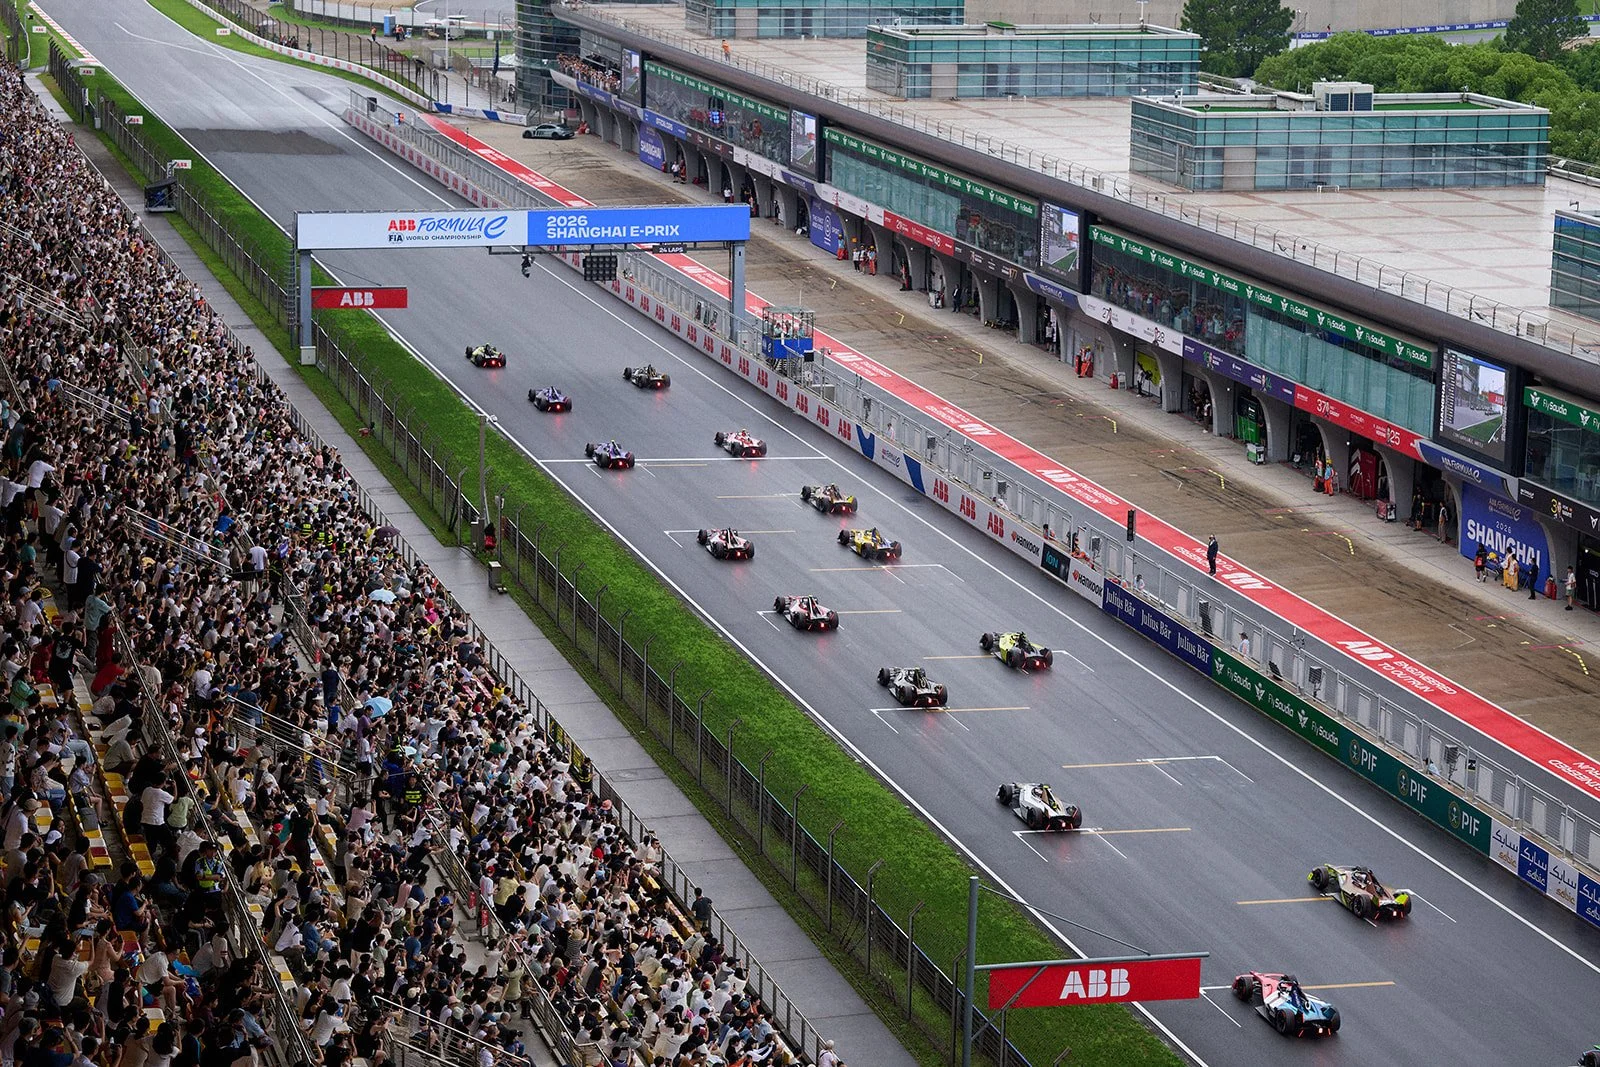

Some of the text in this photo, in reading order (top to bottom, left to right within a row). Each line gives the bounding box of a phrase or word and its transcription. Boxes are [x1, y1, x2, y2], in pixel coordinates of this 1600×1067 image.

[388, 220, 416, 231] ABB
[417, 217, 484, 232] FORMULA
[547, 216, 588, 226] 2026
[547, 225, 680, 238] SHANGHAI E-PRIX
[388, 234, 403, 242] FIA
[340, 292, 374, 306] ABB
[687, 324, 698, 342] ABB
[704, 335, 714, 353] ABB
[720, 345, 732, 365] ABB
[738, 356, 750, 377] ABB
[757, 368, 768, 388] ABB
[776, 380, 788, 401] ABB
[796, 392, 808, 414] ABB
[1542, 399, 1568, 416] FlySaudia
[816, 404, 830, 427] ABB
[838, 418, 852, 441] ABB
[934, 478, 948, 504] ABB
[960, 495, 976, 521] ABB
[987, 512, 1004, 539] ABB
[1496, 521, 1512, 534] 2026
[1467, 519, 1540, 568] SHANGHAI
[1106, 588, 1136, 617] Julius Bär
[1141, 609, 1172, 640] Julius Bär
[1177, 632, 1210, 664] Julius Bär
[1336, 641, 1457, 694] ABB ENGINEERED
[1378, 662, 1434, 692] TO OUTRUN
[1227, 668, 1251, 691] FlySaudia
[1268, 694, 1294, 718] FlySaudia
[1311, 720, 1338, 746] FlySaudia
[1361, 748, 1377, 772] PIF
[1410, 779, 1428, 804] PIF
[1461, 810, 1480, 837] PIF
[1059, 968, 1131, 1000] ABB
